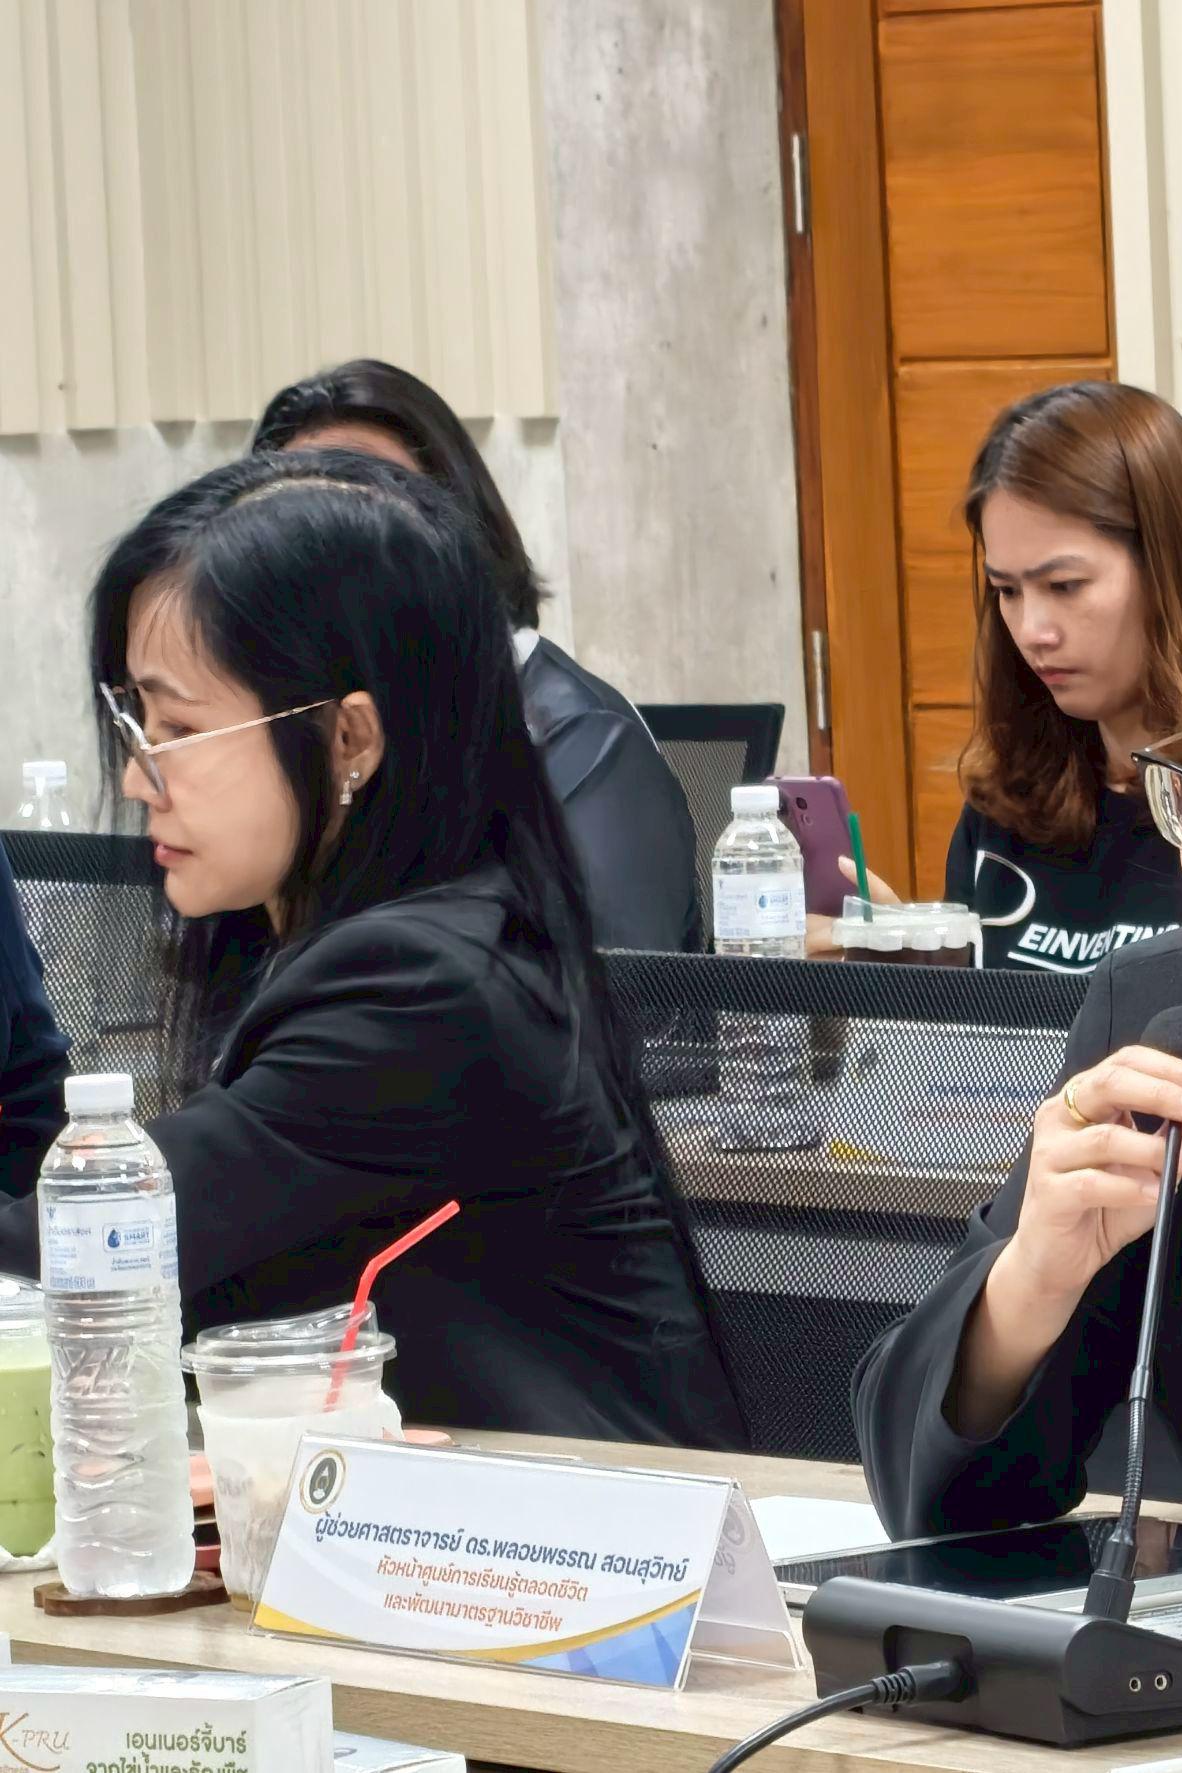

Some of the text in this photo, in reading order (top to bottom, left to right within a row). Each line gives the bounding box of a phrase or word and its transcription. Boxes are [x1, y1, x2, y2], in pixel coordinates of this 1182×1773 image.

[315, 1511, 464, 1552] ผู้ช่วยศาสตราจารย์
[465, 1536, 597, 1570] ดร.พลอยพรรณ
[601, 1552, 689, 1584] สอนสุวิทย์
[377, 1555, 589, 1601] หัวหน้าศูนย์การเรียนรู้ตลอดชีวิต
[383, 1593, 563, 1632] และพัฒนามาตรฐานวิชาชีพ
[126, 1723, 247, 1754] เอนเนอร์จี้บาร์
